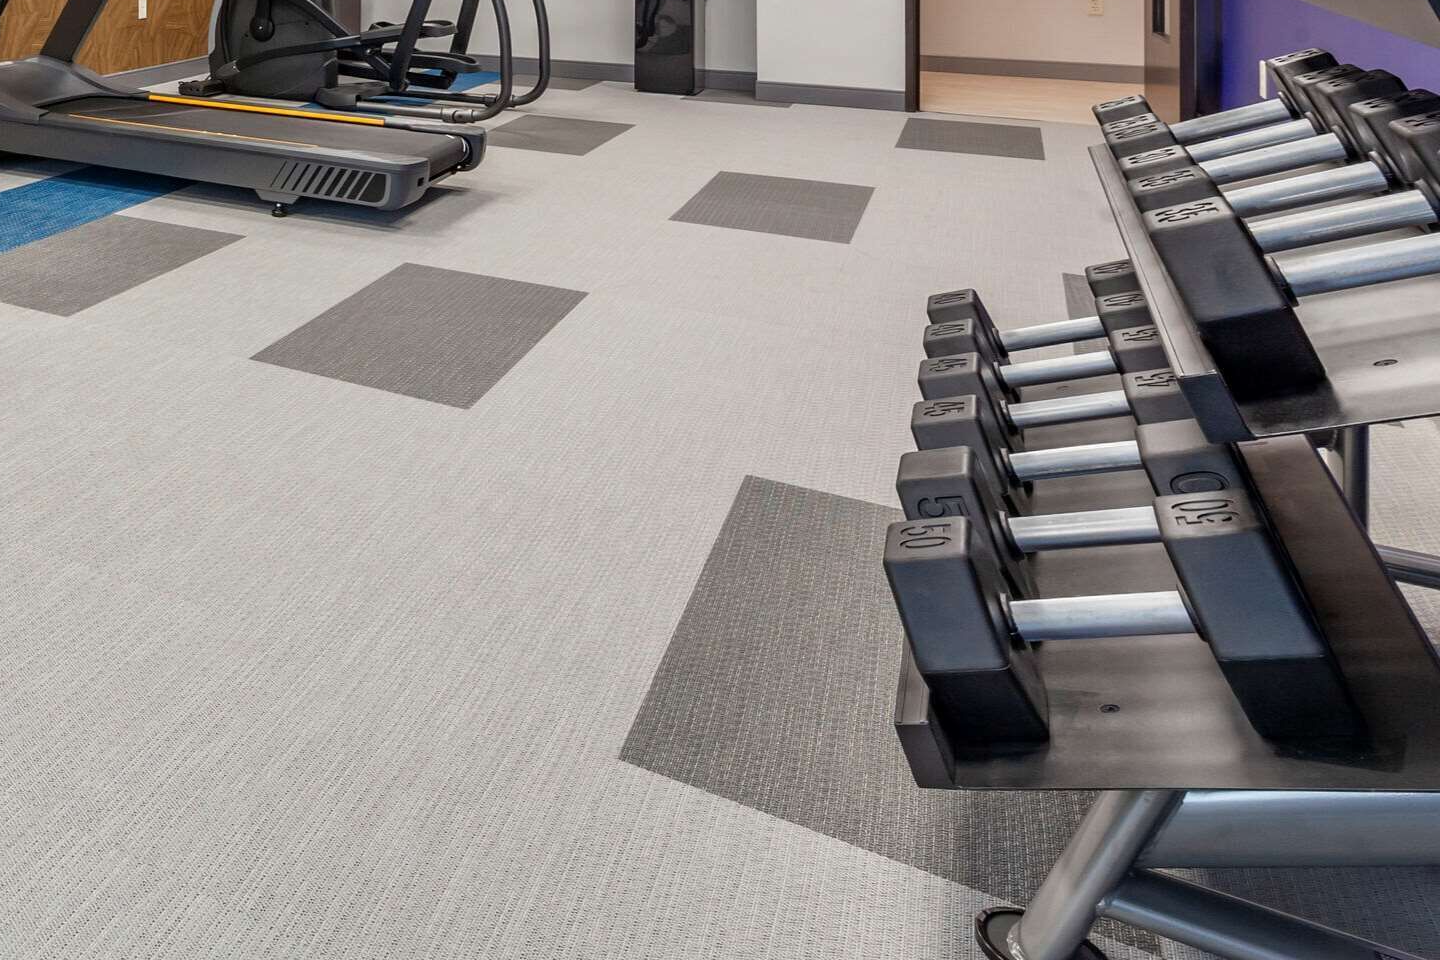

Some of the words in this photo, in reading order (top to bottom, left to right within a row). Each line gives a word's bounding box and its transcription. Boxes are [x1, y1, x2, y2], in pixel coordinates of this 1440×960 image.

[1155, 202, 1219, 223] 35
[923, 401, 965, 417] 45
[1171, 499, 1241, 526] 50
[900, 523, 953, 549] 50
